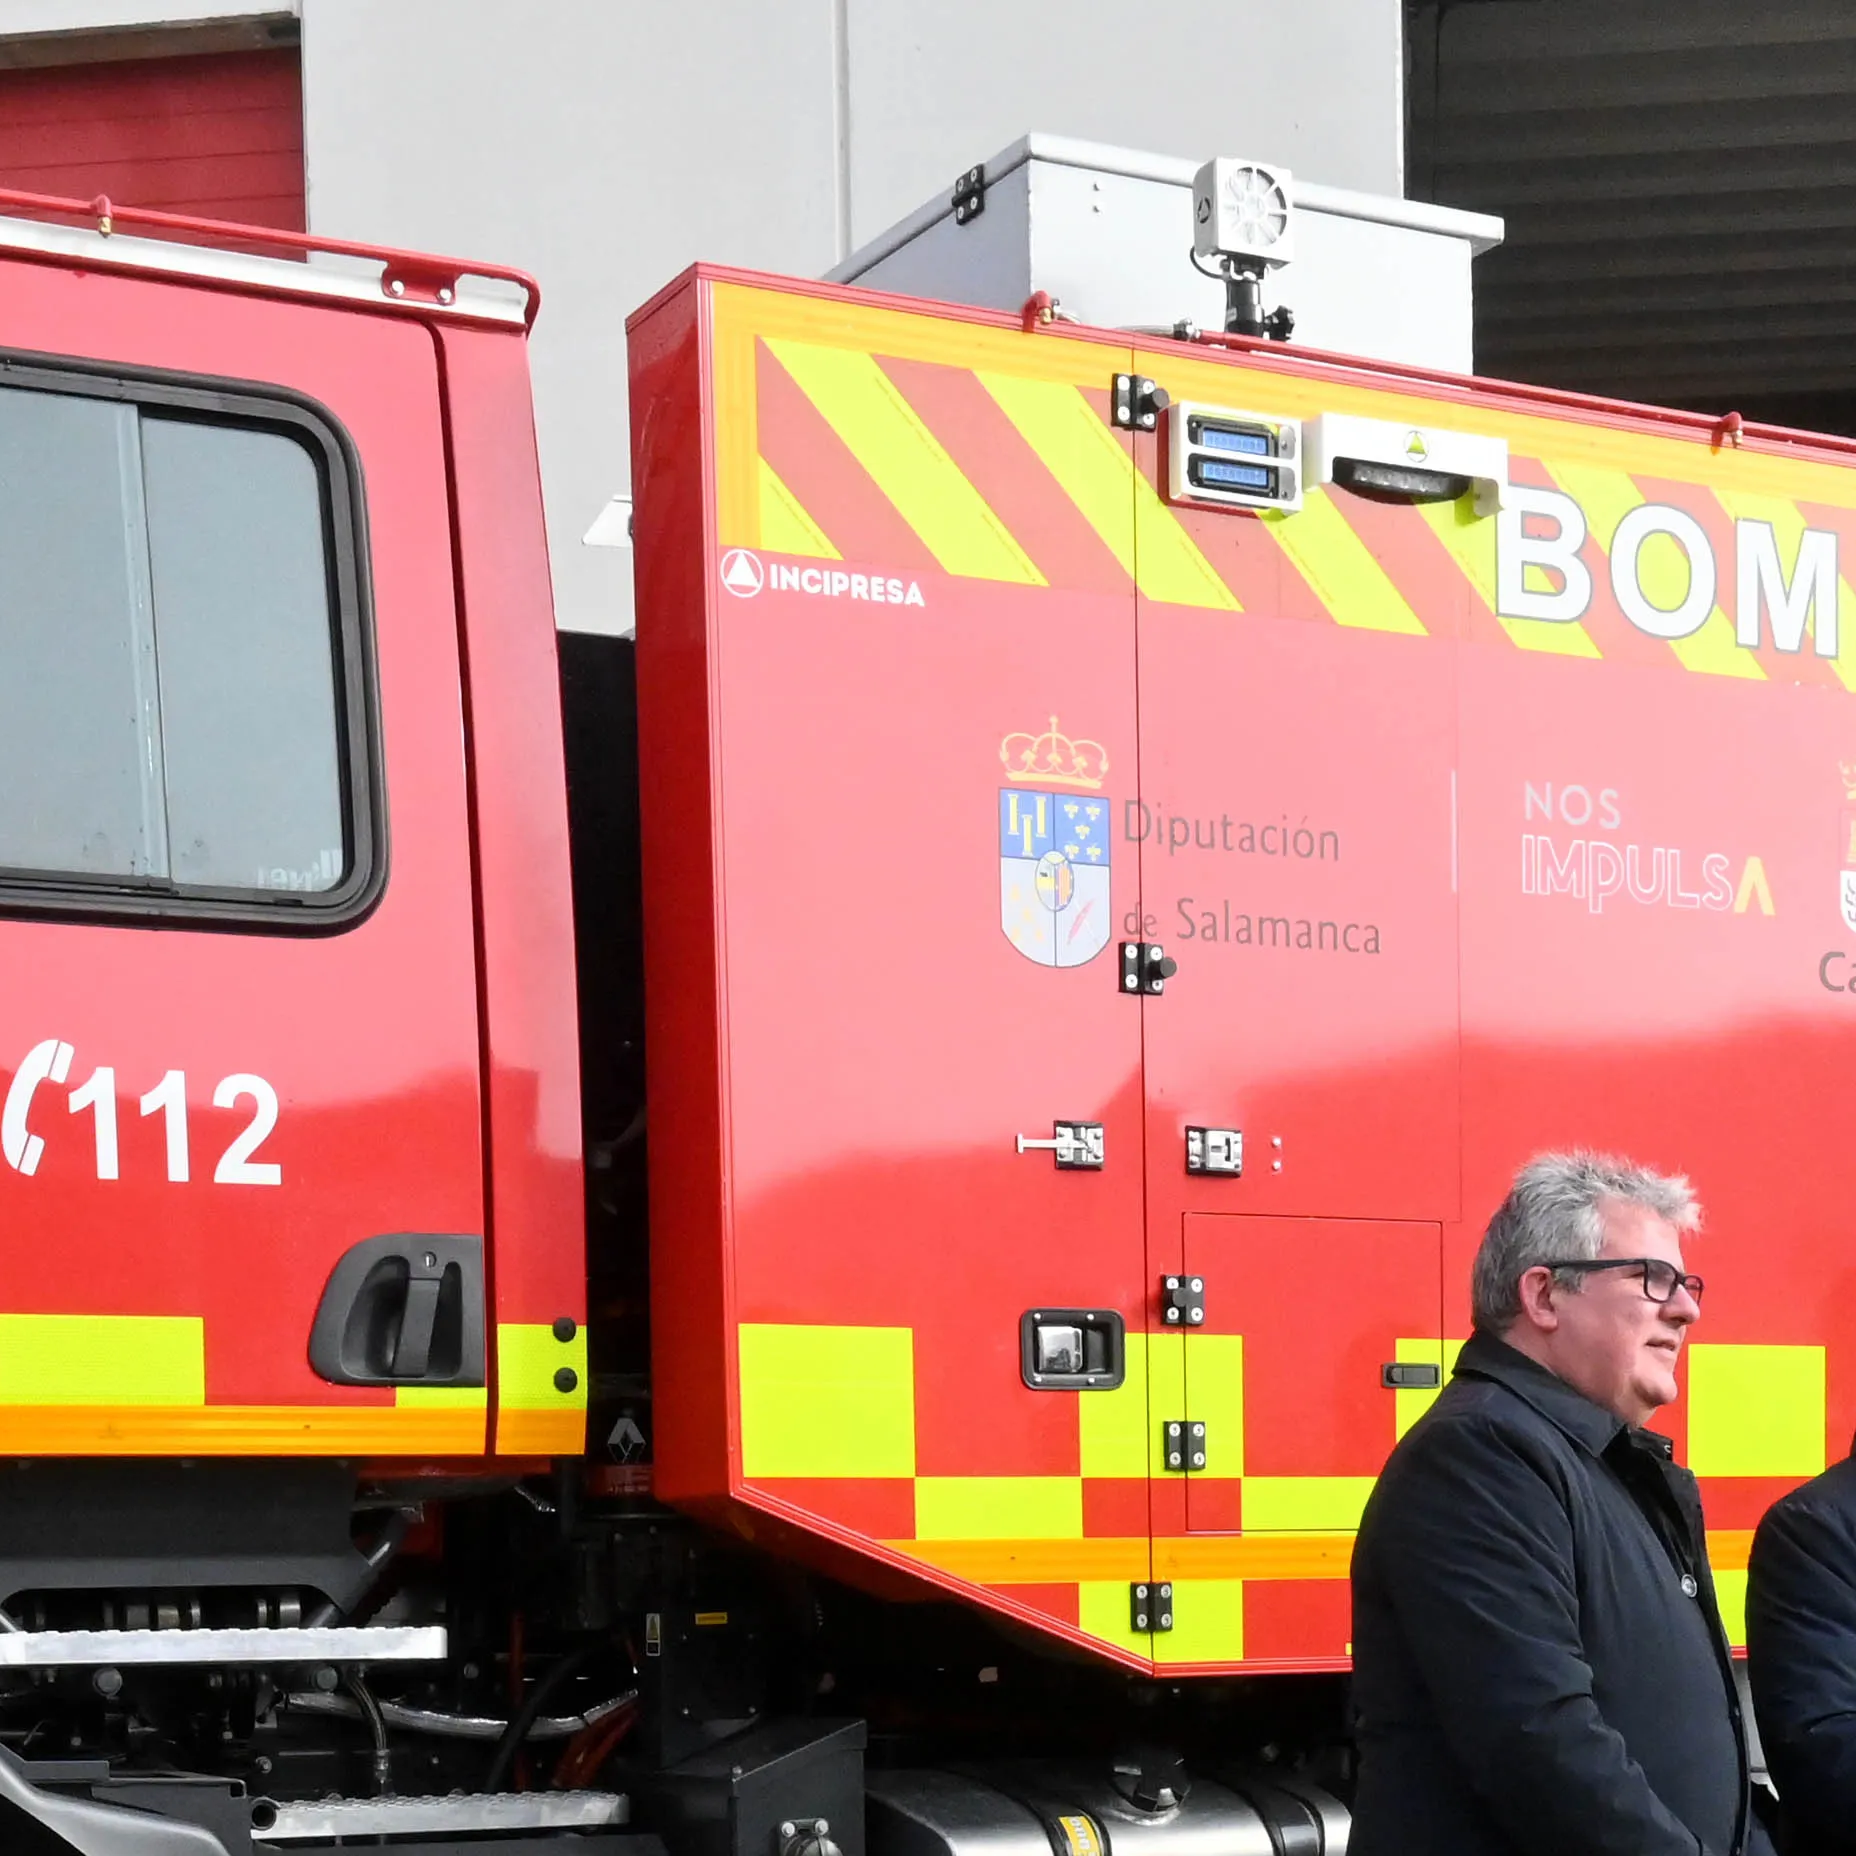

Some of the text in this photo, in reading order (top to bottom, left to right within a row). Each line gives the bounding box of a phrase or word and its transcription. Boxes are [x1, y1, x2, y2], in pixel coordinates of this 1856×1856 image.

[769, 563, 926, 607] INCIPRESA
[1124, 799, 1340, 862] Diputación
[1524, 780, 1622, 830] NOS
[1521, 833, 1777, 916] IMPULSA
[1123, 897, 1381, 955] de Salamanca
[67, 1065, 283, 1186] 112
